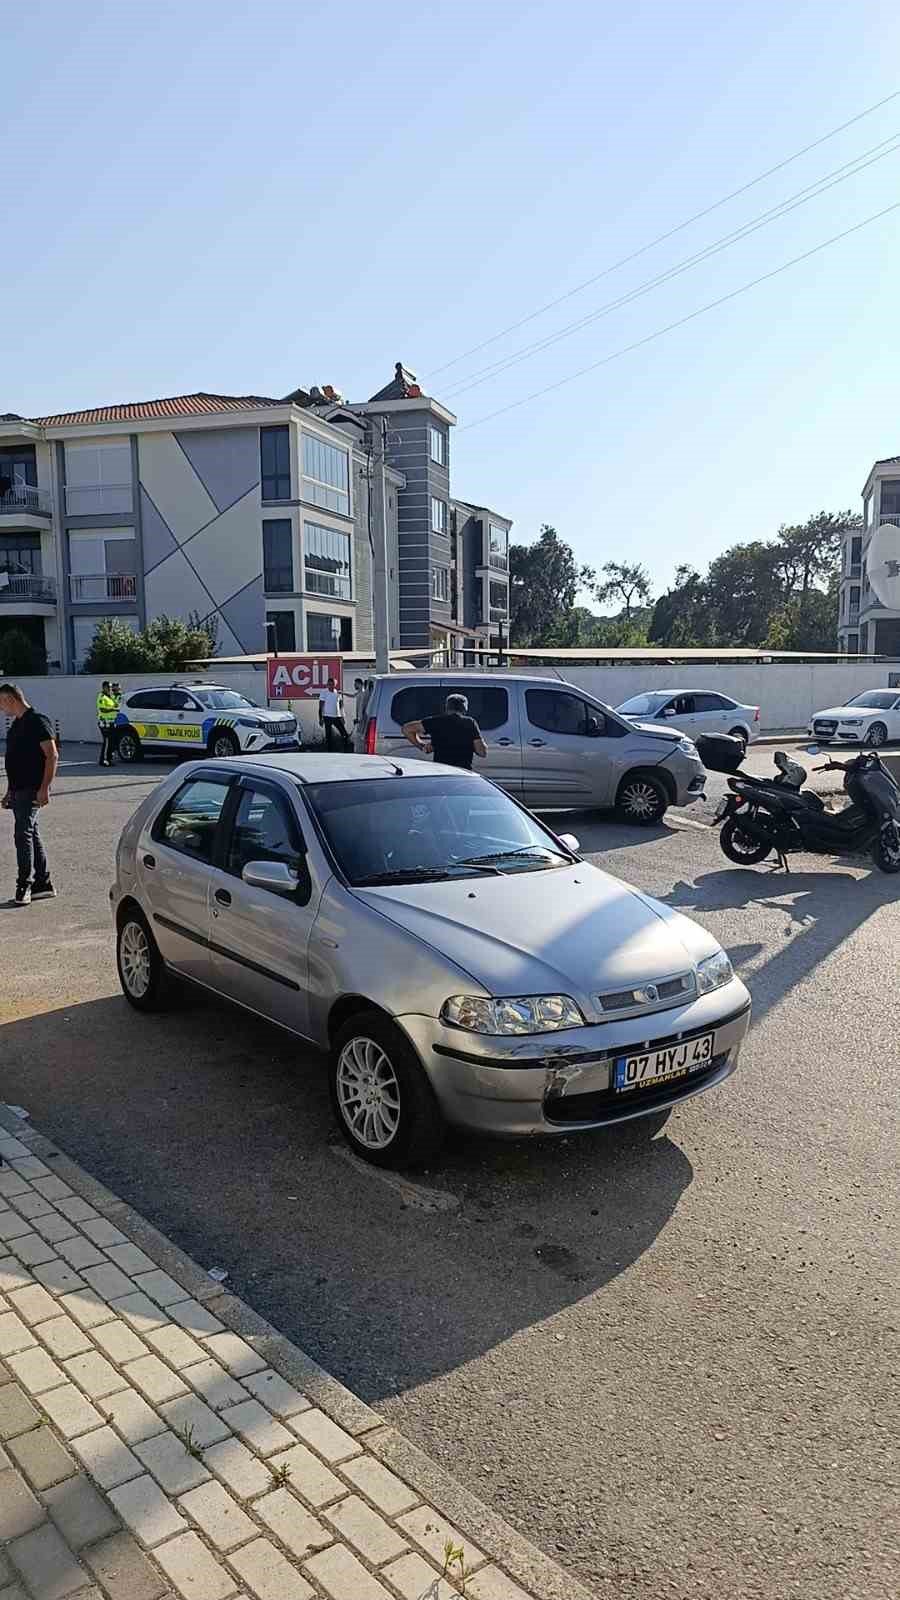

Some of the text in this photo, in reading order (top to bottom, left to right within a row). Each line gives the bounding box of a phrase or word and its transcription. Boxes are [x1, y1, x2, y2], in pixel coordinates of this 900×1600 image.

[275, 686, 283, 697] H
[627, 1056, 649, 1082] 07
[656, 1045, 688, 1074] HYJ
[692, 1038, 710, 1061] 43
[639, 1069, 687, 1089] UZMANLAR
